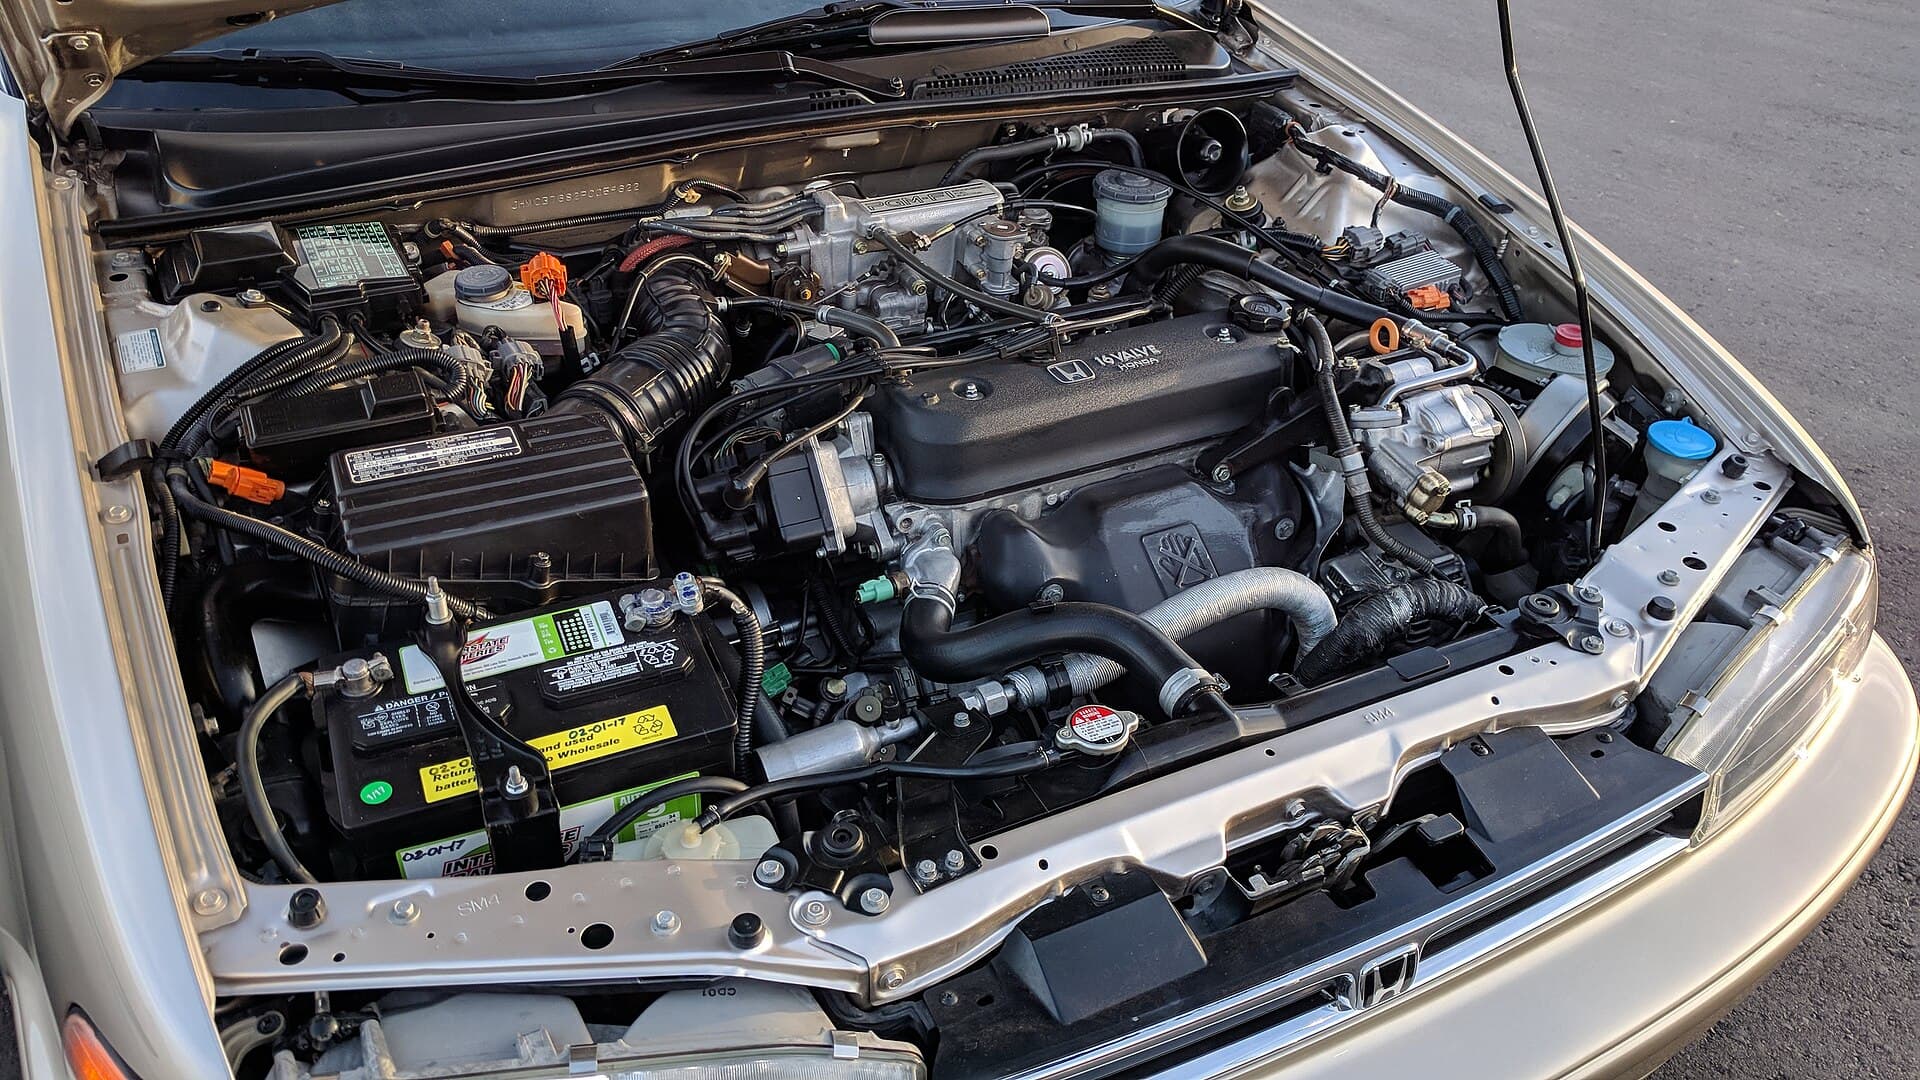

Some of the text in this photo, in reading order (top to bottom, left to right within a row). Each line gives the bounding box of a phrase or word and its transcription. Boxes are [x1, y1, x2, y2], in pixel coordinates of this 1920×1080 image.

[1110, 344, 1162, 363] VALVE
[1117, 356, 1160, 371] HONDA
[385, 695, 429, 709] DANGER
[569, 717, 627, 740] 02-01-17
[558, 738, 620, 759] Wholesale
[565, 733, 594, 747] used
[457, 894, 500, 917] SM4
[702, 987, 737, 997] CD01
